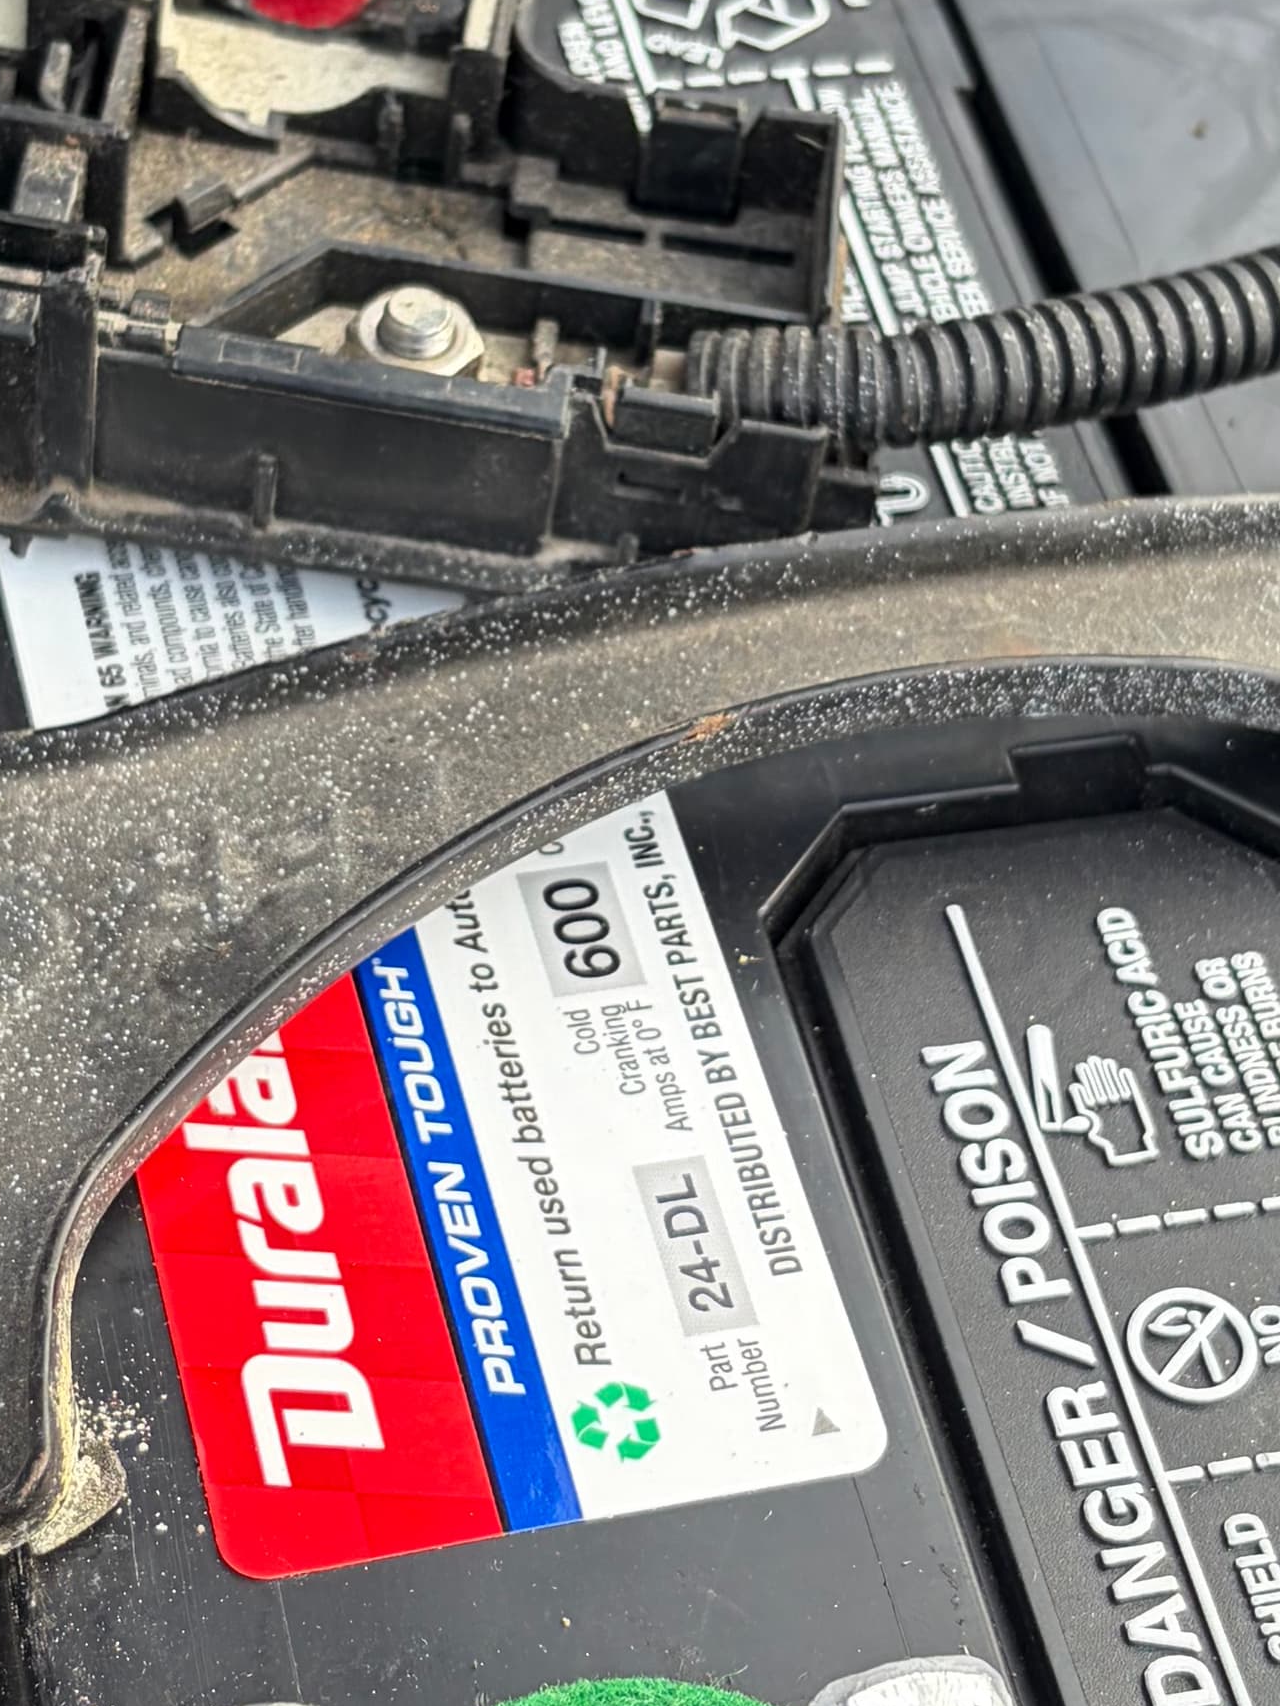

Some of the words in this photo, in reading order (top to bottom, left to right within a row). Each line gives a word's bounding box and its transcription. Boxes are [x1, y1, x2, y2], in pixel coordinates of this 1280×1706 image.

[595, 39, 633, 80] AND
[640, 32, 725, 71] LEAD
[843, 164, 905, 259] STARTING
[878, 169, 933, 252] OWNERS
[921, 198, 977, 278] SERVICE
[881, 263, 927, 316] JUMP
[910, 254, 961, 323] EHICLE
[954, 280, 991, 319] EEK
[951, 440, 1005, 515] CAUTIO
[1018, 440, 1060, 483] NOT
[1038, 488, 1070, 507] IF
[72, 568, 120, 661] WARNING
[108, 570, 143, 620] related
[181, 580, 214, 625] cause
[209, 577, 242, 612] also
[240, 578, 272, 600] of
[248, 596, 281, 637] State
[119, 616, 152, 649] and
[190, 623, 217, 643] to
[289, 619, 317, 650] fter
[95, 660, 129, 693] 65
[129, 648, 165, 699] minals,
[170, 663, 195, 687] ad
[542, 878, 621, 979] 600
[642, 874, 697, 966] PARTS,
[1096, 906, 1161, 989] ACID
[469, 963, 499, 993] to
[1195, 956, 1237, 998] OR
[562, 1008, 601, 1055] Cold
[624, 999, 653, 1013] F
[672, 974, 723, 1041] BEST
[600, 1003, 647, 1096] Cranking
[642, 1045, 671, 1066] at
[697, 1051, 738, 1085] BY
[1173, 998, 1236, 1085] CAUSE
[481, 1003, 545, 1144] batteries
[655, 1071, 694, 1132] Amps
[1127, 989, 1226, 1158] SULFURIC
[1213, 1092, 1263, 1151] CAN
[517, 1157, 572, 1235] used
[714, 1092, 803, 1277] DISTRIBUTED
[921, 1040, 1074, 1303] POISON
[182, 1030, 385, 1487] Durala
[655, 1173, 735, 1312] 24-DL
[427, 1161, 526, 1395] PROVEN
[553, 1249, 612, 1366] Return
[699, 1341, 739, 1392] Part
[736, 1338, 787, 1433] Number
